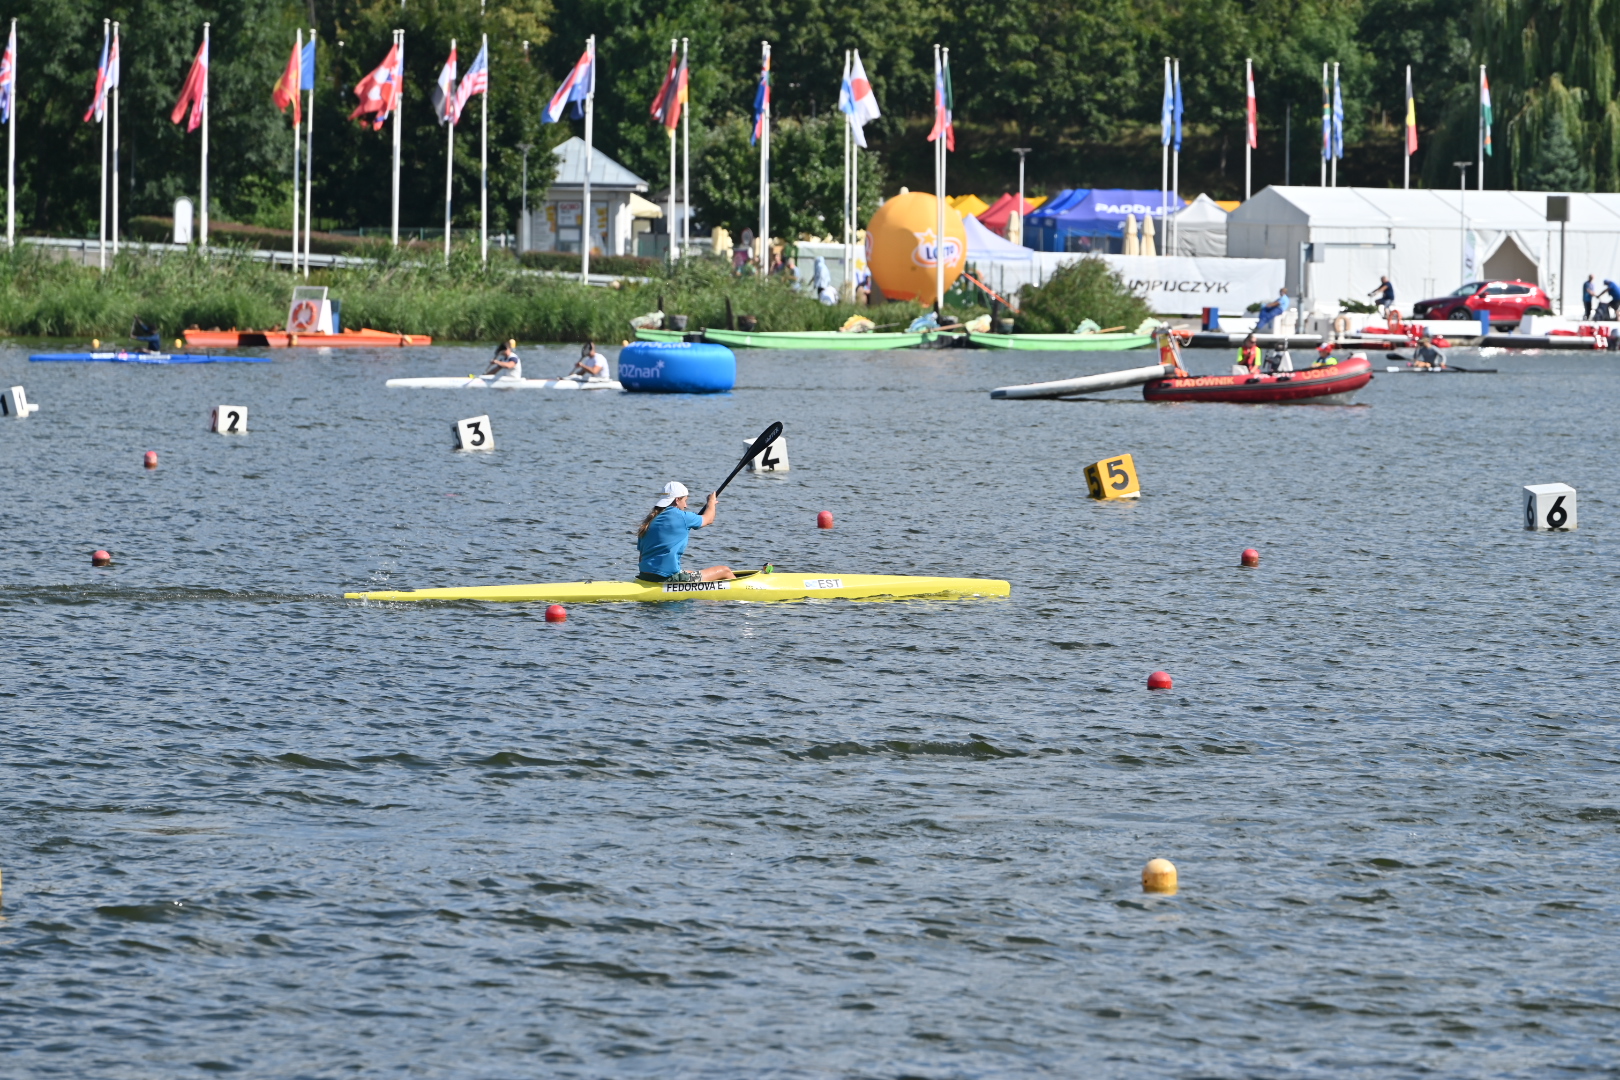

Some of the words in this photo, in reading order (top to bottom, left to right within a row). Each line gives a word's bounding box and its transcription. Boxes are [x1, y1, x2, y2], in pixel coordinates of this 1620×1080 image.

[227, 410, 240, 431] 2
[466, 421, 486, 447] 3
[761, 445, 780, 470] 4
[1106, 459, 1129, 491] 5
[1546, 495, 1568, 528] 6
[666, 581, 716, 592] FEDOROVA
[717, 581, 726, 590] E.
[817, 578, 840, 588] EST
